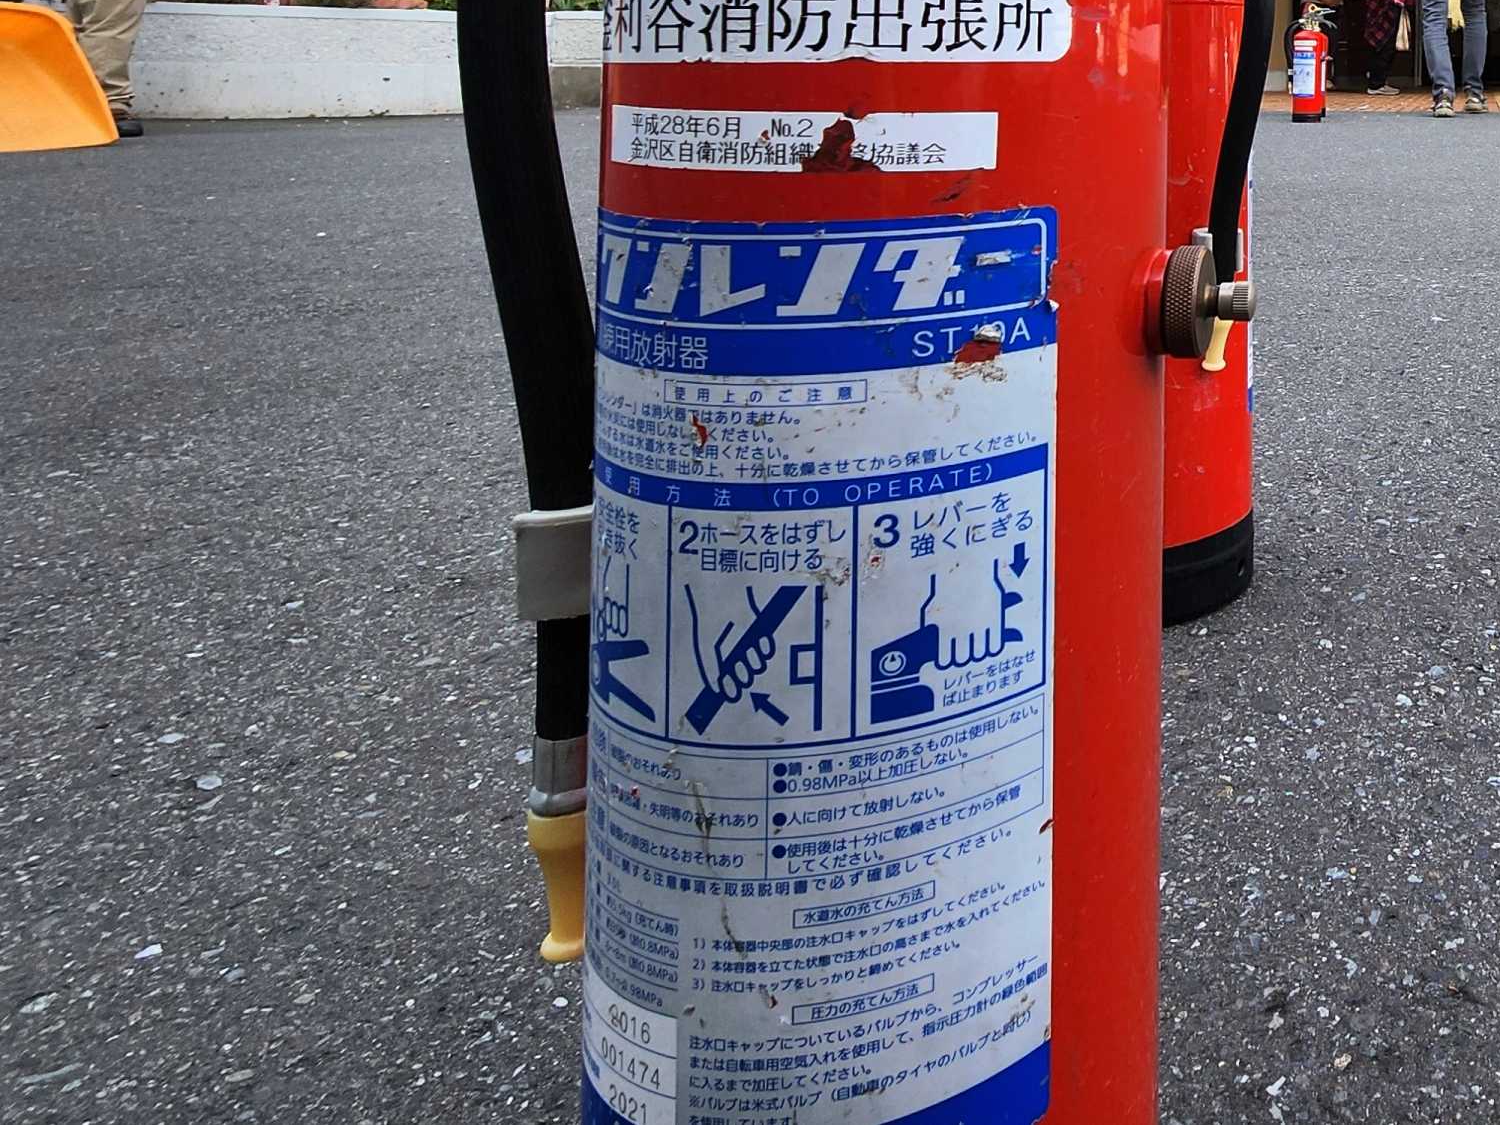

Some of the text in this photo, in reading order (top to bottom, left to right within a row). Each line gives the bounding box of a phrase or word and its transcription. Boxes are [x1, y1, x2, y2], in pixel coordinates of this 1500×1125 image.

[631, 112, 814, 142] 平成28年6月 No.2
[845, 463, 993, 503] OPERATE)
[678, 519, 847, 556] 2 ホースをはずし
[872, 491, 1011, 549] 3 レバーを
[910, 509, 1033, 559] 強くにぎる
[700, 547, 824, 573] 目標に向ける
[601, 1036, 661, 1091] 001474
